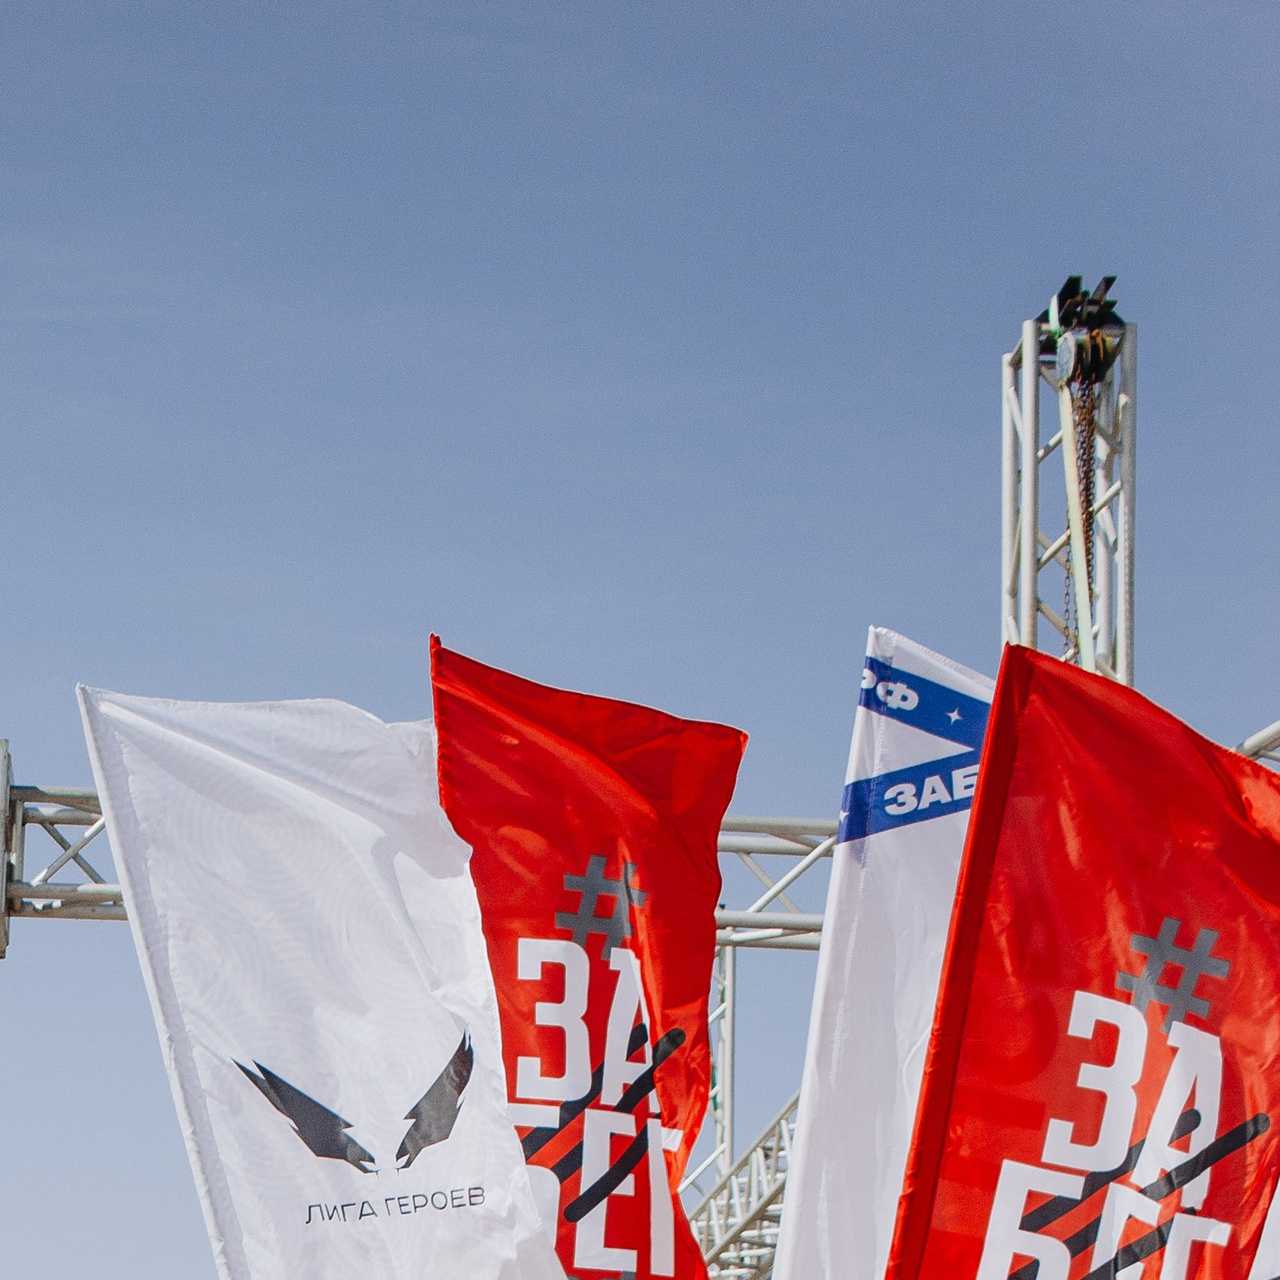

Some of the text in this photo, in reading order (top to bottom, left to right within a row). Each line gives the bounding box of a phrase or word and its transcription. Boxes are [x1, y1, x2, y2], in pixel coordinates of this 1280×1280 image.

[515, 937, 662, 1113] ЗА
[1041, 989, 1223, 1211] ЗА
[305, 1186, 486, 1225] ЛИГА ГЕРОЕВ
